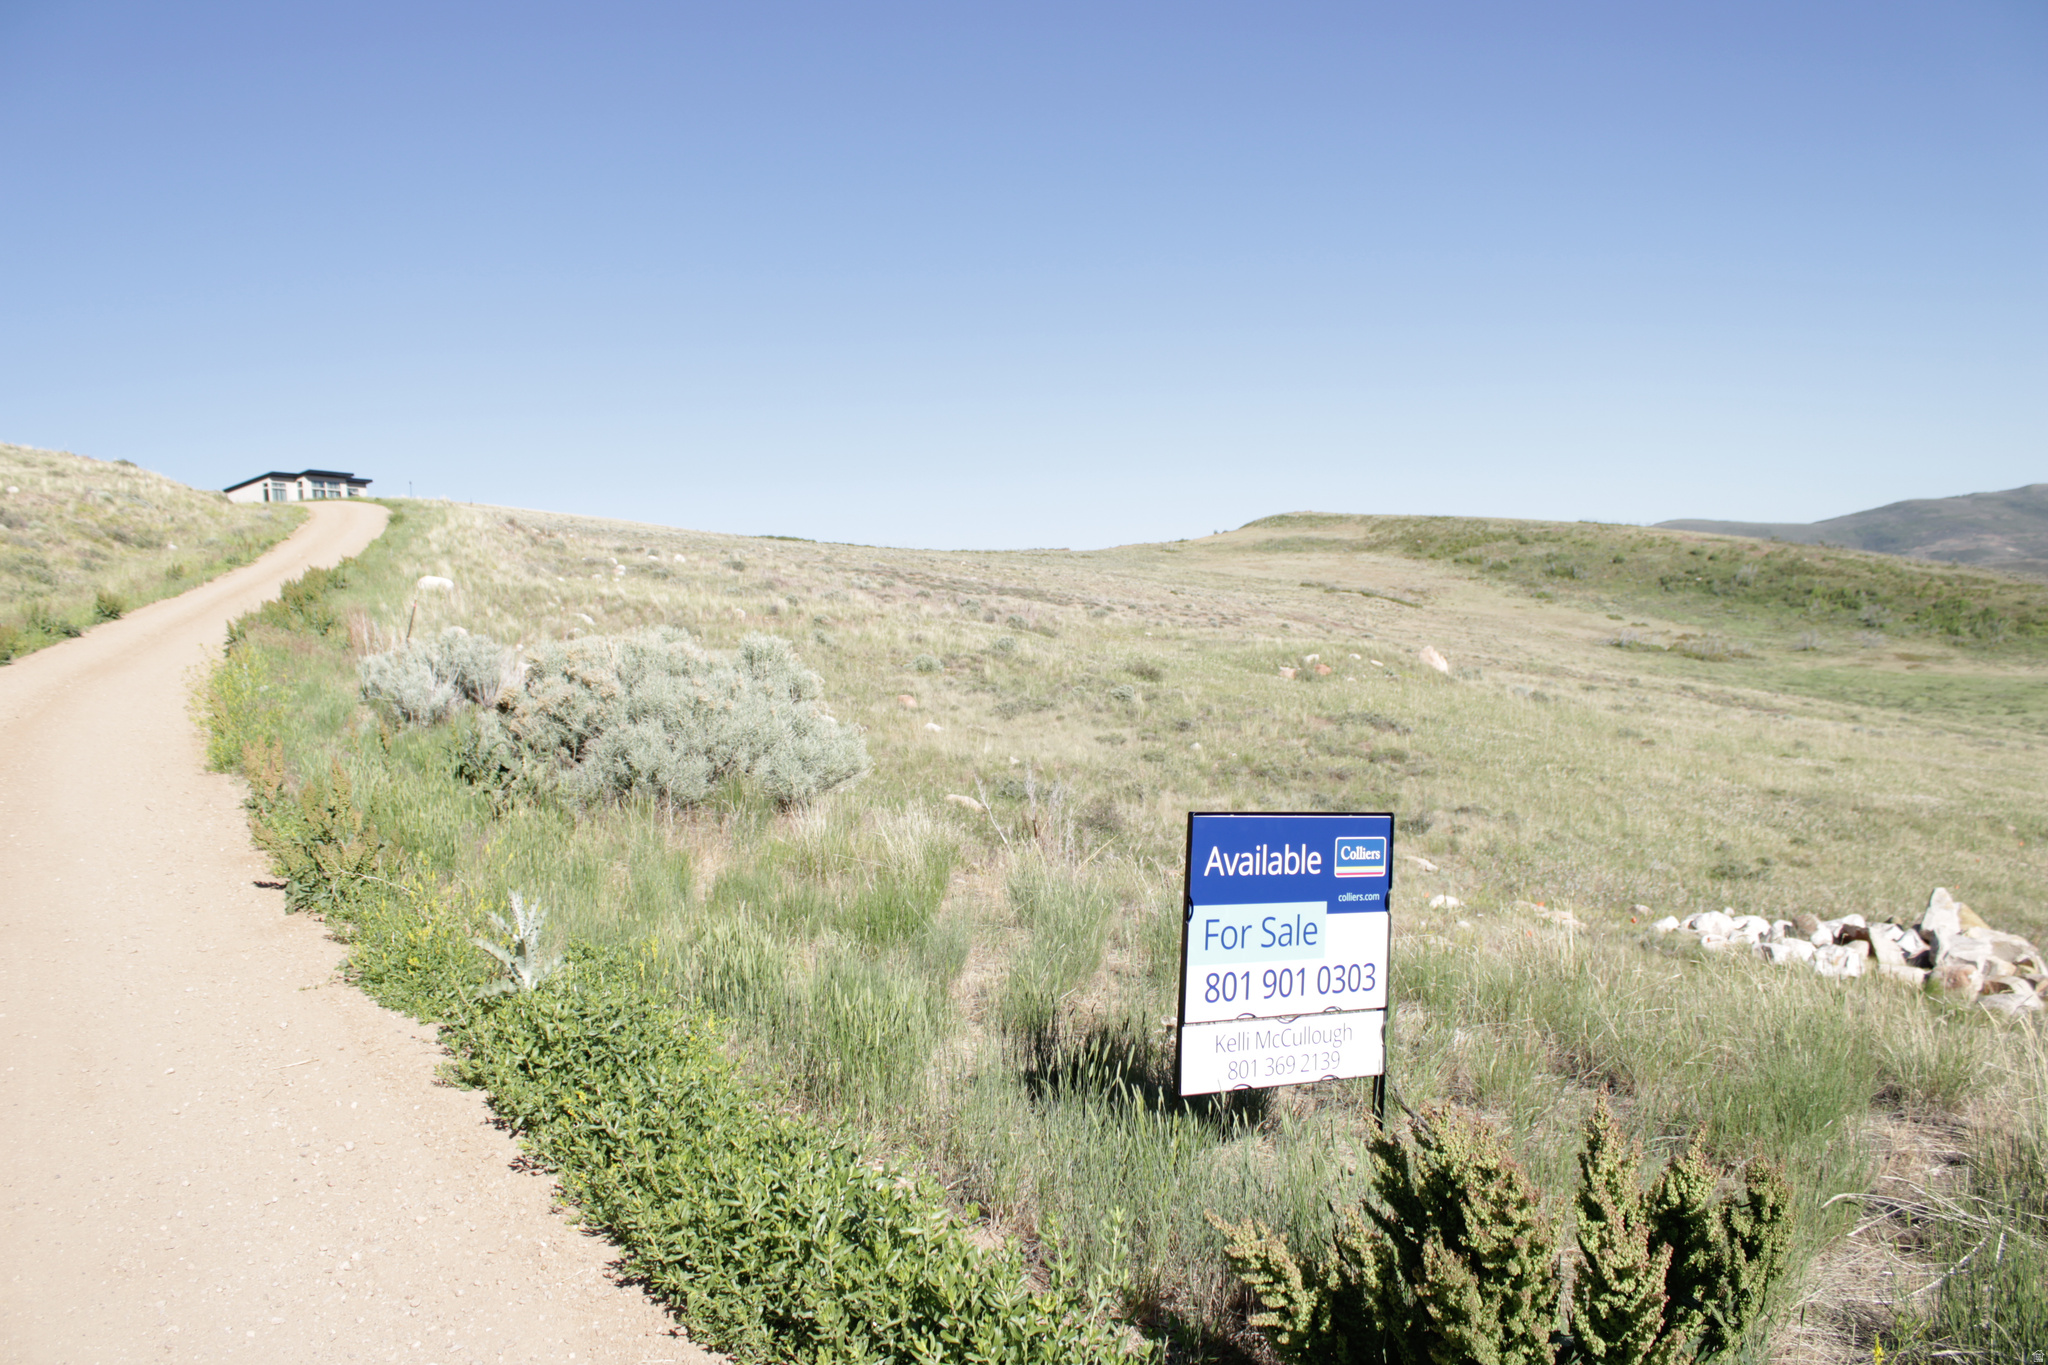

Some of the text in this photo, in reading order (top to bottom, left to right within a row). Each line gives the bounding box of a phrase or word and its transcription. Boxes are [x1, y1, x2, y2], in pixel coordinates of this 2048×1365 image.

[1203, 843, 1322, 877] Available
[1340, 845, 1381, 860] Colliers
[1338, 892, 1380, 902] colliers.com
[1204, 913, 1318, 951] For Sale
[1204, 962, 1376, 1003] 801 901 0303
[1215, 1022, 1353, 1053] Kelli McCullough
[1227, 1050, 1341, 1080] 801 369 2139
